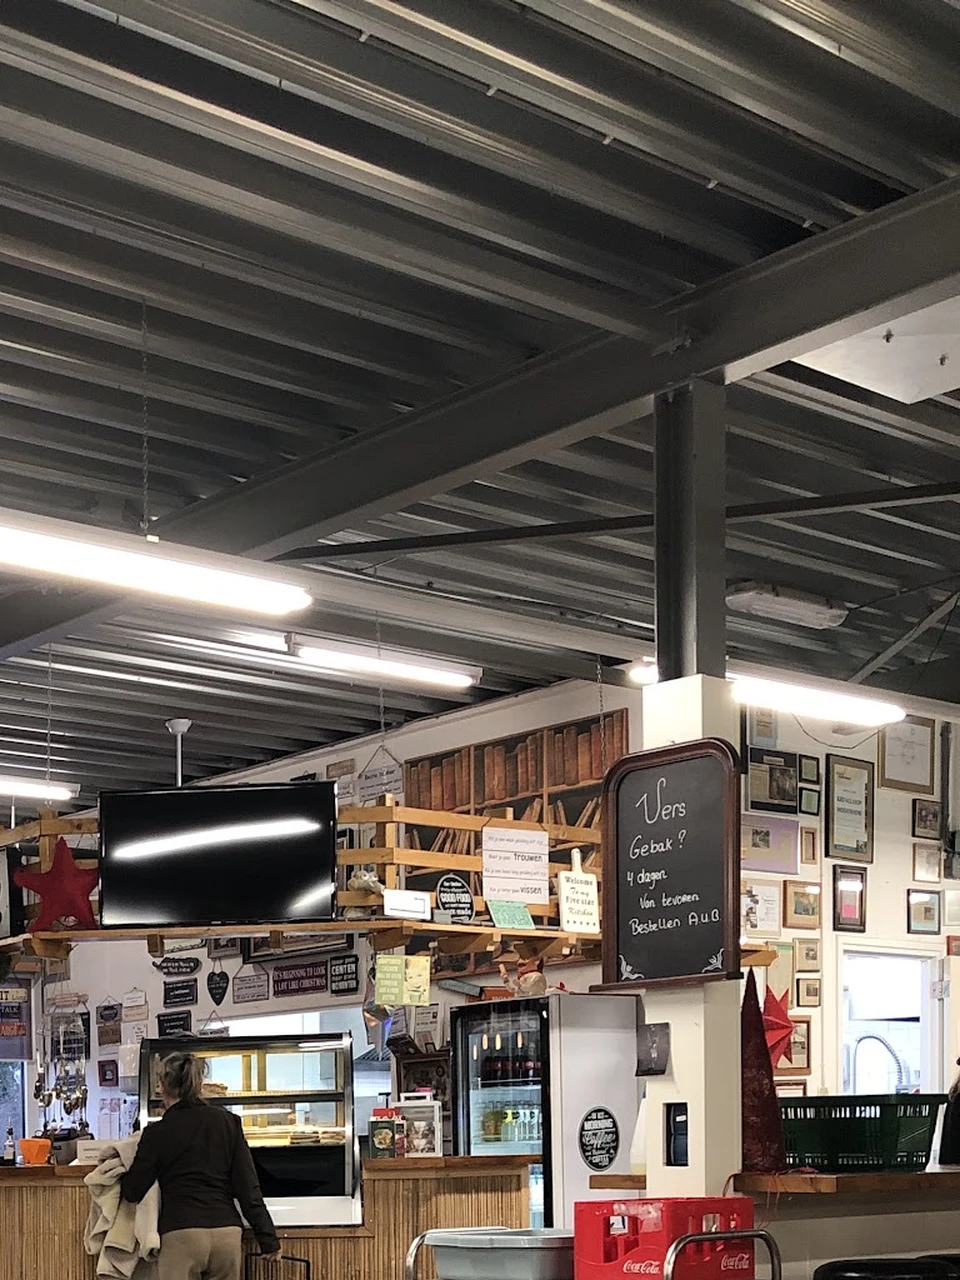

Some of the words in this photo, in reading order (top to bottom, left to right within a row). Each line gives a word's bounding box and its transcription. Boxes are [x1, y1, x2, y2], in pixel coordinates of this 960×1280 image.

[635, 777, 687, 824] Vers
[514, 852, 543, 862] trouwen
[564, 875, 594, 886] Welcome
[626, 871, 635, 887] 4
[637, 868, 669, 890] dagen
[520, 884, 542, 895] vissen
[661, 892, 701, 907] tevoren
[629, 918, 681, 936] Bestellen
